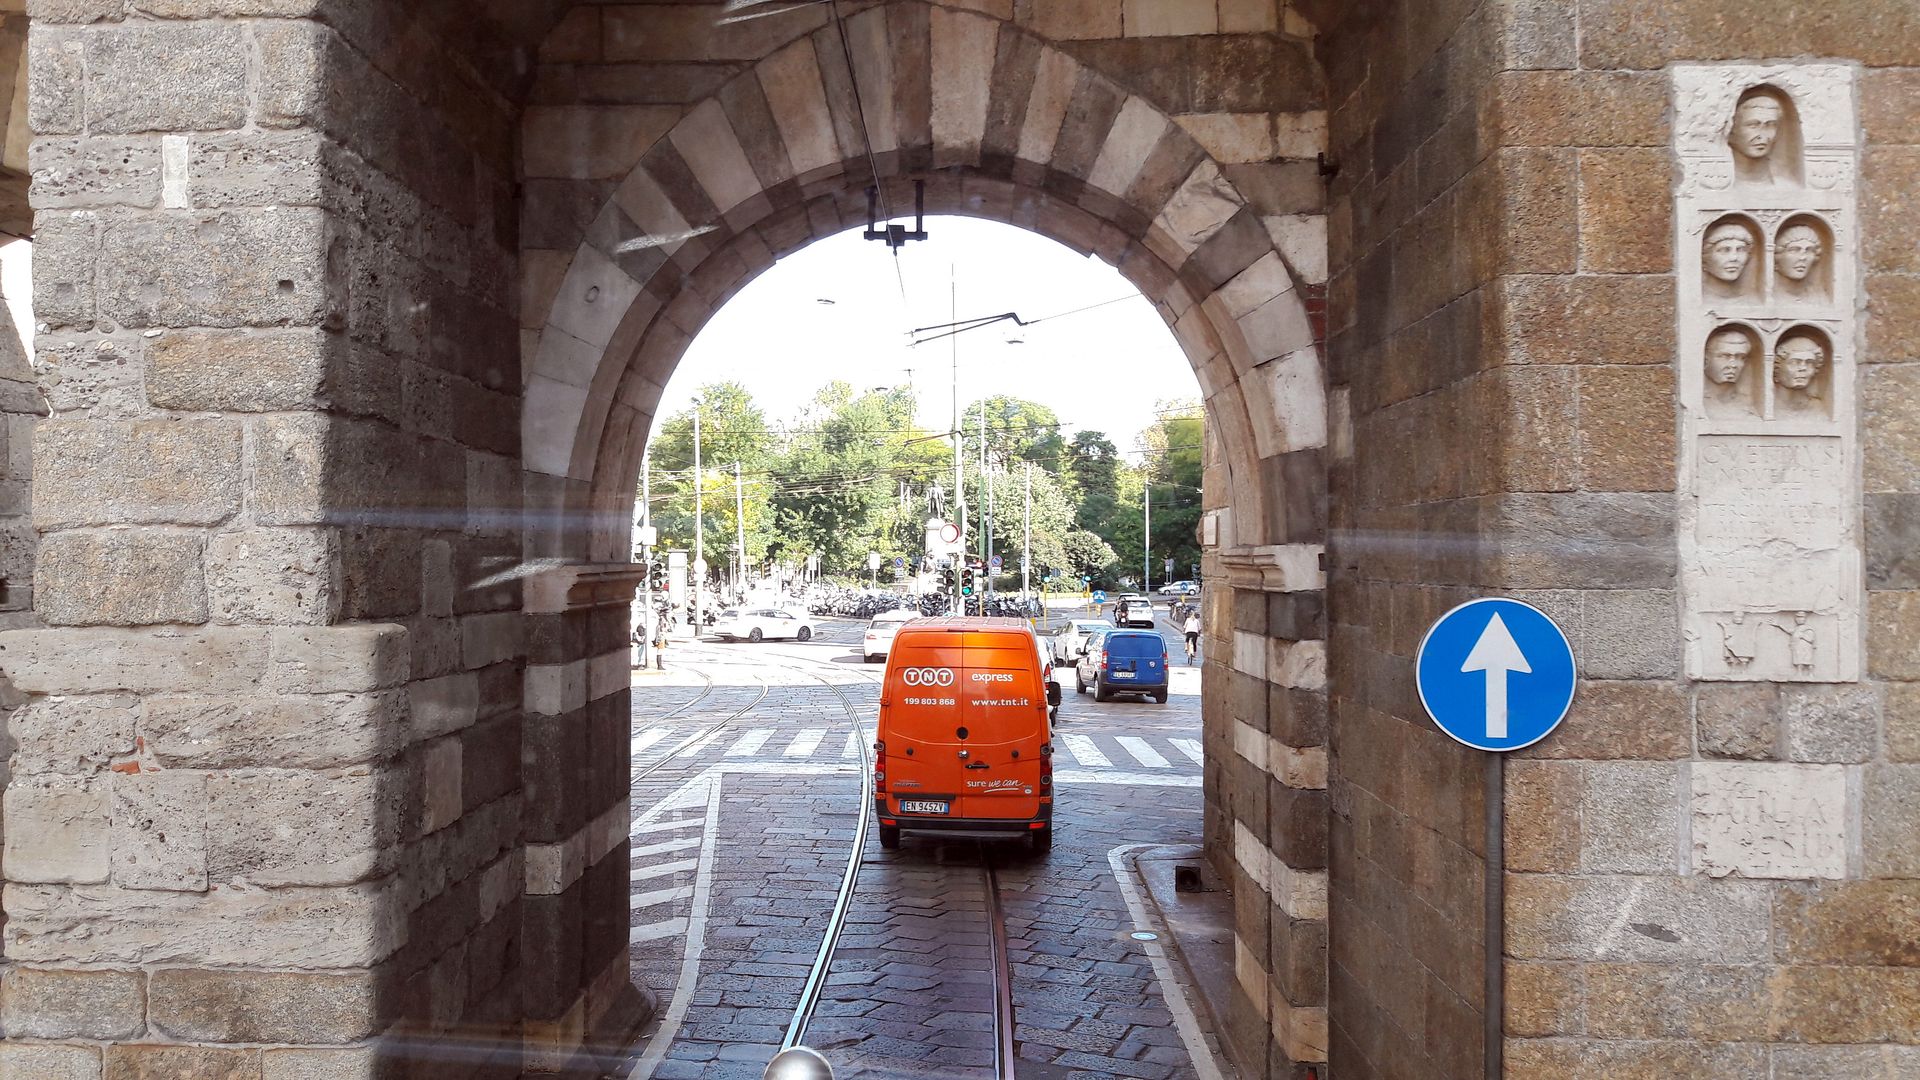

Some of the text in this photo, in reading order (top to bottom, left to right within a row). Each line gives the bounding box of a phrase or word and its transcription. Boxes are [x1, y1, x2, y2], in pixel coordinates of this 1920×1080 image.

[905, 669, 952, 684] TNT
[972, 672, 1013, 684] express
[939, 698, 955, 706] 868
[972, 697, 1029, 706] www.tnt.it
[988, 779, 1001, 788] we
[1002, 779, 1024, 787] can
[906, 801, 917, 811] EN
